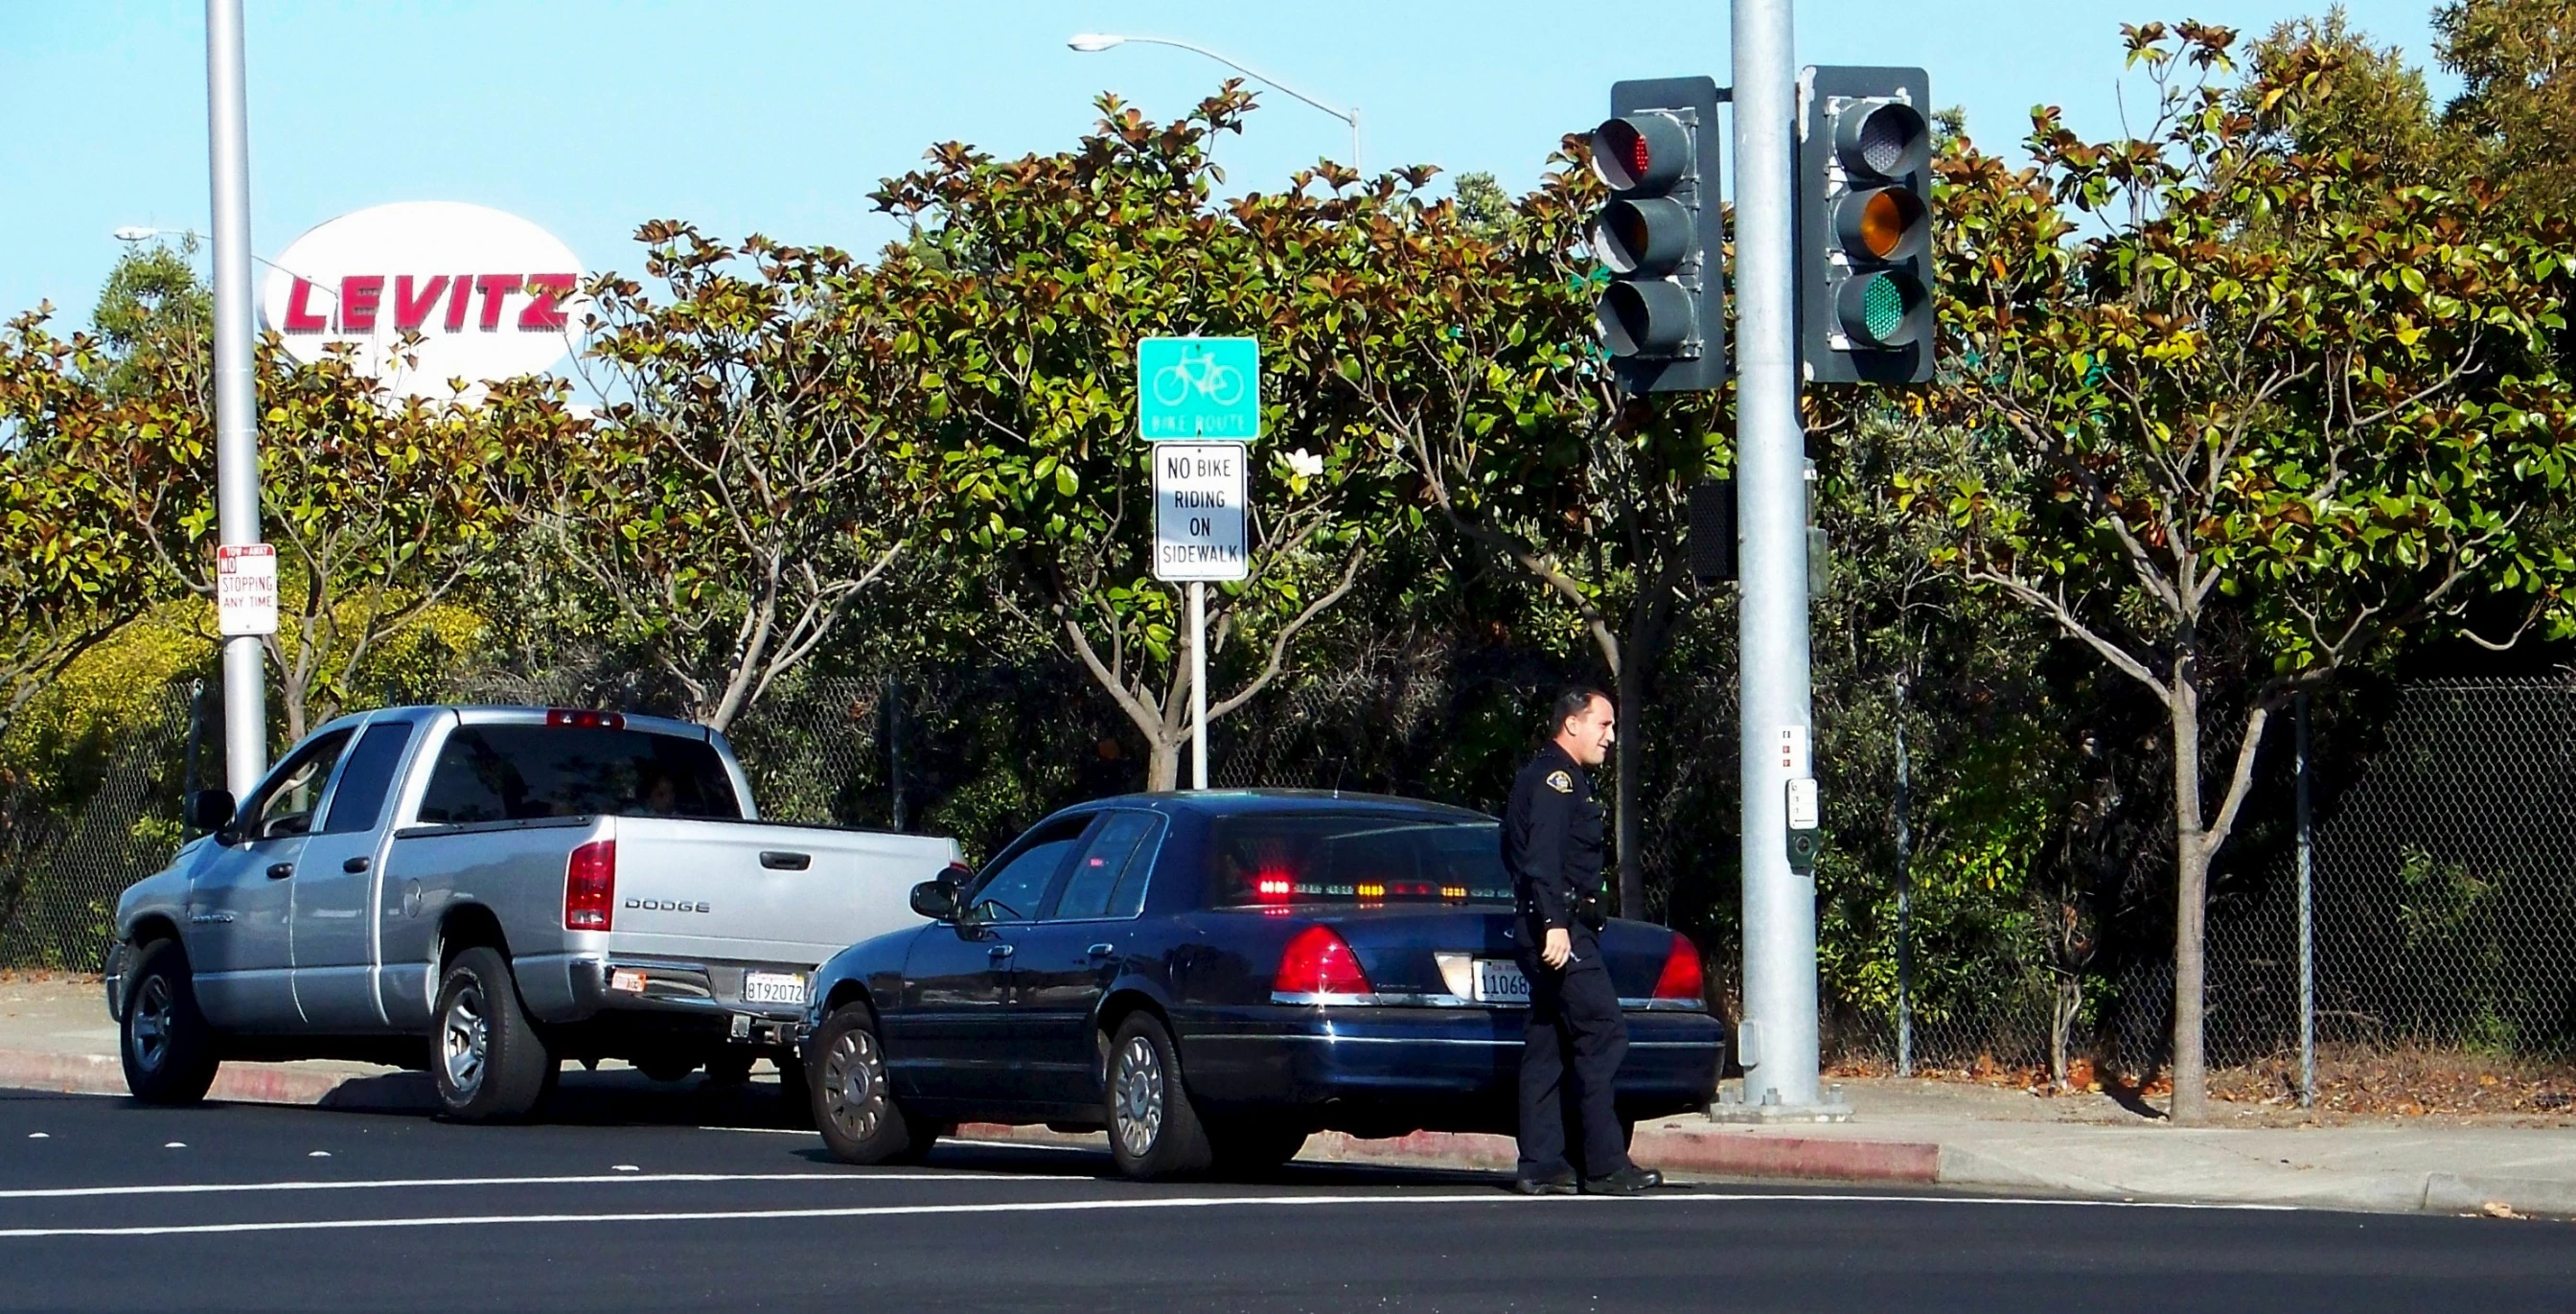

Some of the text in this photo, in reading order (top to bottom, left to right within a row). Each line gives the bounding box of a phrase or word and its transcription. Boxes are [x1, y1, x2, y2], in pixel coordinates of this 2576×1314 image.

[284, 273, 577, 334] LEVITZ
[1151, 413, 1245, 432] BIKE ROUTE
[1167, 457, 1231, 479] NO BIKE
[1174, 491, 1226, 509] RIDING
[1189, 518, 1210, 537] ON
[1162, 544, 1238, 564] SIDEWALK
[219, 557, 237, 573] NO
[222, 576, 273, 592] STOPPING
[223, 595, 273, 608] ANY TIME
[625, 897, 710, 913] DODGE
[748, 982, 803, 1003] 8T92072
